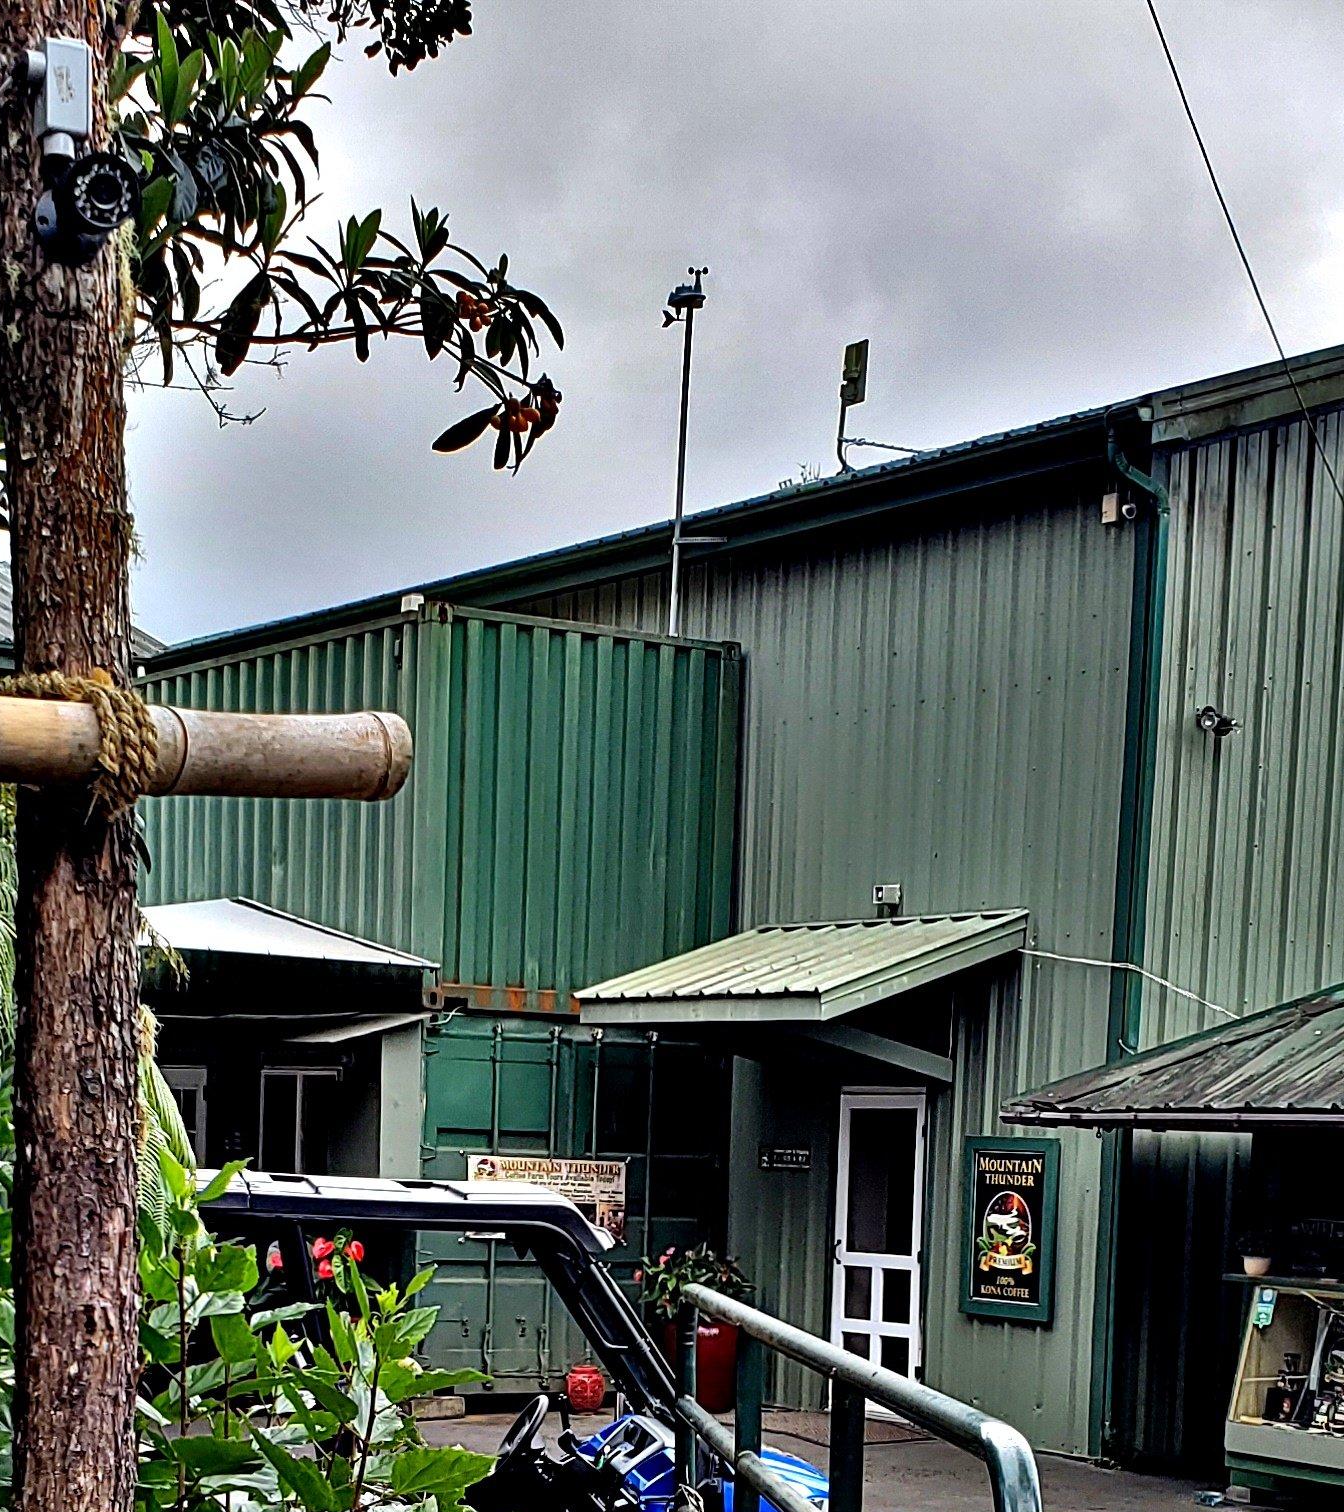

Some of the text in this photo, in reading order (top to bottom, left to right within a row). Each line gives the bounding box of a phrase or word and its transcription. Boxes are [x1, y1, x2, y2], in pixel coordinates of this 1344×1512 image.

[500, 1160, 562, 1173] MOUNTAIN
[979, 1157, 1043, 1173] MOUNTAIN
[985, 1173, 1035, 1187] THUNDER
[980, 1285, 1030, 1299] KONA COFFEE
